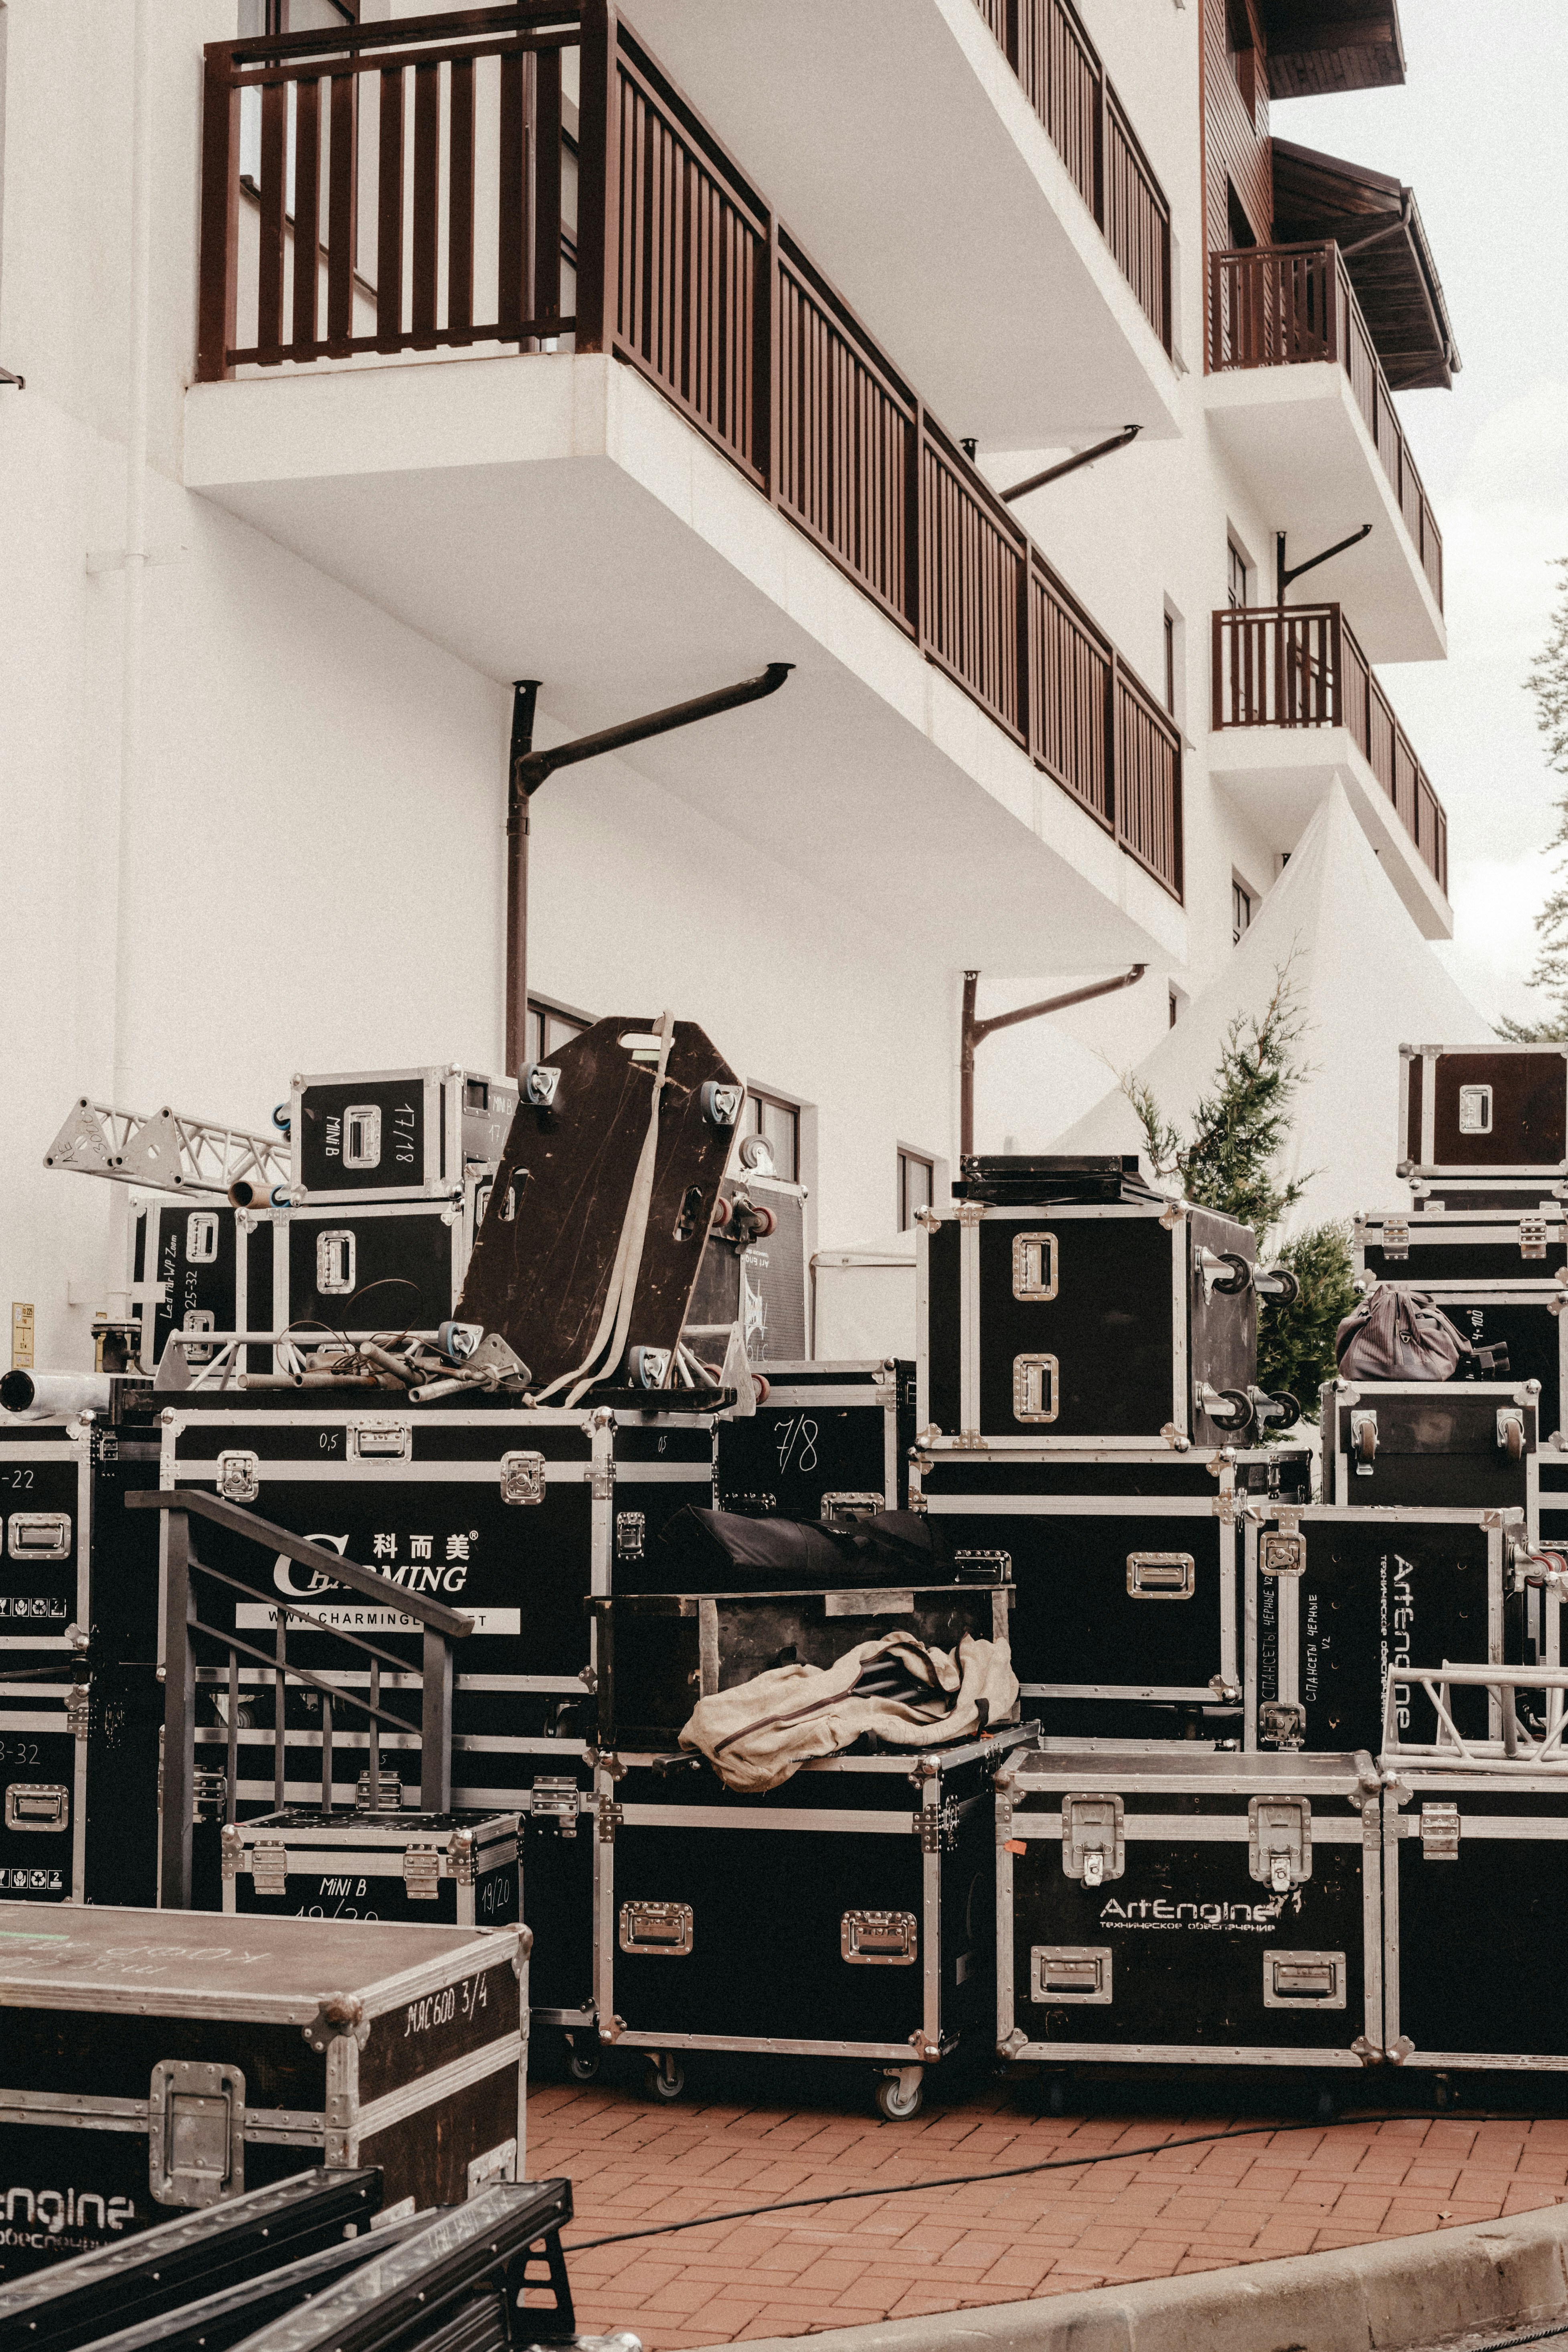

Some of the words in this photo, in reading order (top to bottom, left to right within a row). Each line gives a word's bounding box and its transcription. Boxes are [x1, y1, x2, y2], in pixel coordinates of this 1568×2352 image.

[507, 1099, 512, 1115] B
[82, 1114, 107, 1154] 3000
[393, 1103, 415, 1162] 17/18
[326, 1147, 340, 1156] B
[165, 1235, 177, 1258] Zoom
[164, 1259, 175, 1275] WP
[184, 1271, 197, 1309] 25-32
[160, 1297, 173, 1318] Led
[320, 1433, 339, 1451] 0,5
[658, 1436, 668, 1453] 0,5
[775, 1414, 818, 1474] 7/8
[1264, 1576, 1273, 1585] V2
[1263, 1590, 1275, 1625] ЧЕРНЫЕ
[1307, 1594, 1318, 1636] ЧЕРНЫЕ
[1321, 1636, 1330, 1649] V2
[1394, 1554, 1414, 1729] ArtEngne
[1262, 1632, 1277, 1699] СПАНСЕТЫ
[1306, 1644, 1318, 1701] СПАНСЕТЫ
[53, 1872, 59, 1881] 2
[356, 1878, 366, 1897] B
[482, 1876, 509, 1914] 19/20
[1100, 1898, 1275, 1923] ArtEngine
[462, 1972, 487, 2021] 3/4
[0, 2188, 135, 2233] ngine
